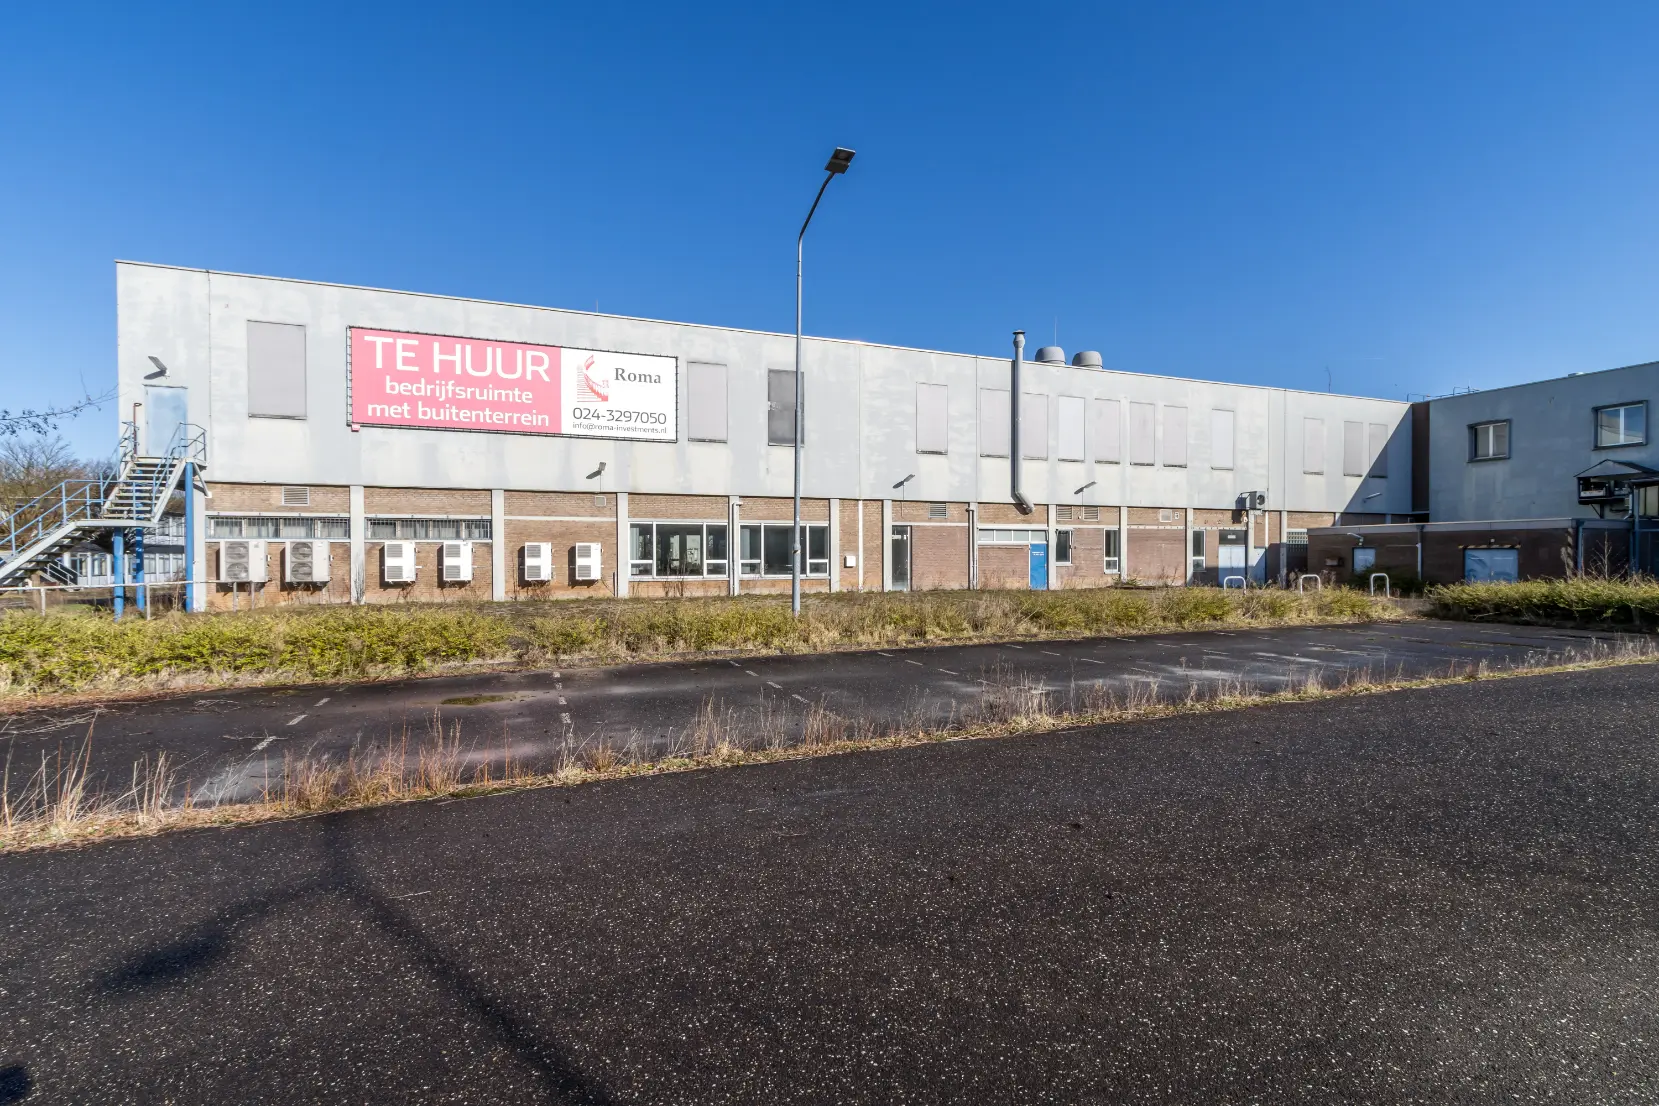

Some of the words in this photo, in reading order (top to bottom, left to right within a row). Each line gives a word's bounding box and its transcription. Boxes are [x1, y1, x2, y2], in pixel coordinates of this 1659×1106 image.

[364, 335, 420, 372] TE
[433, 342, 550, 382] HUUR
[614, 367, 662, 384] Roma
[385, 375, 533, 404] bedrijfsruimte
[367, 402, 411, 419] met
[418, 401, 549, 426] buitenterrein
[572, 407, 667, 425] 024-3297050
[572, 421, 667, 434] info@roma-investments.nl
